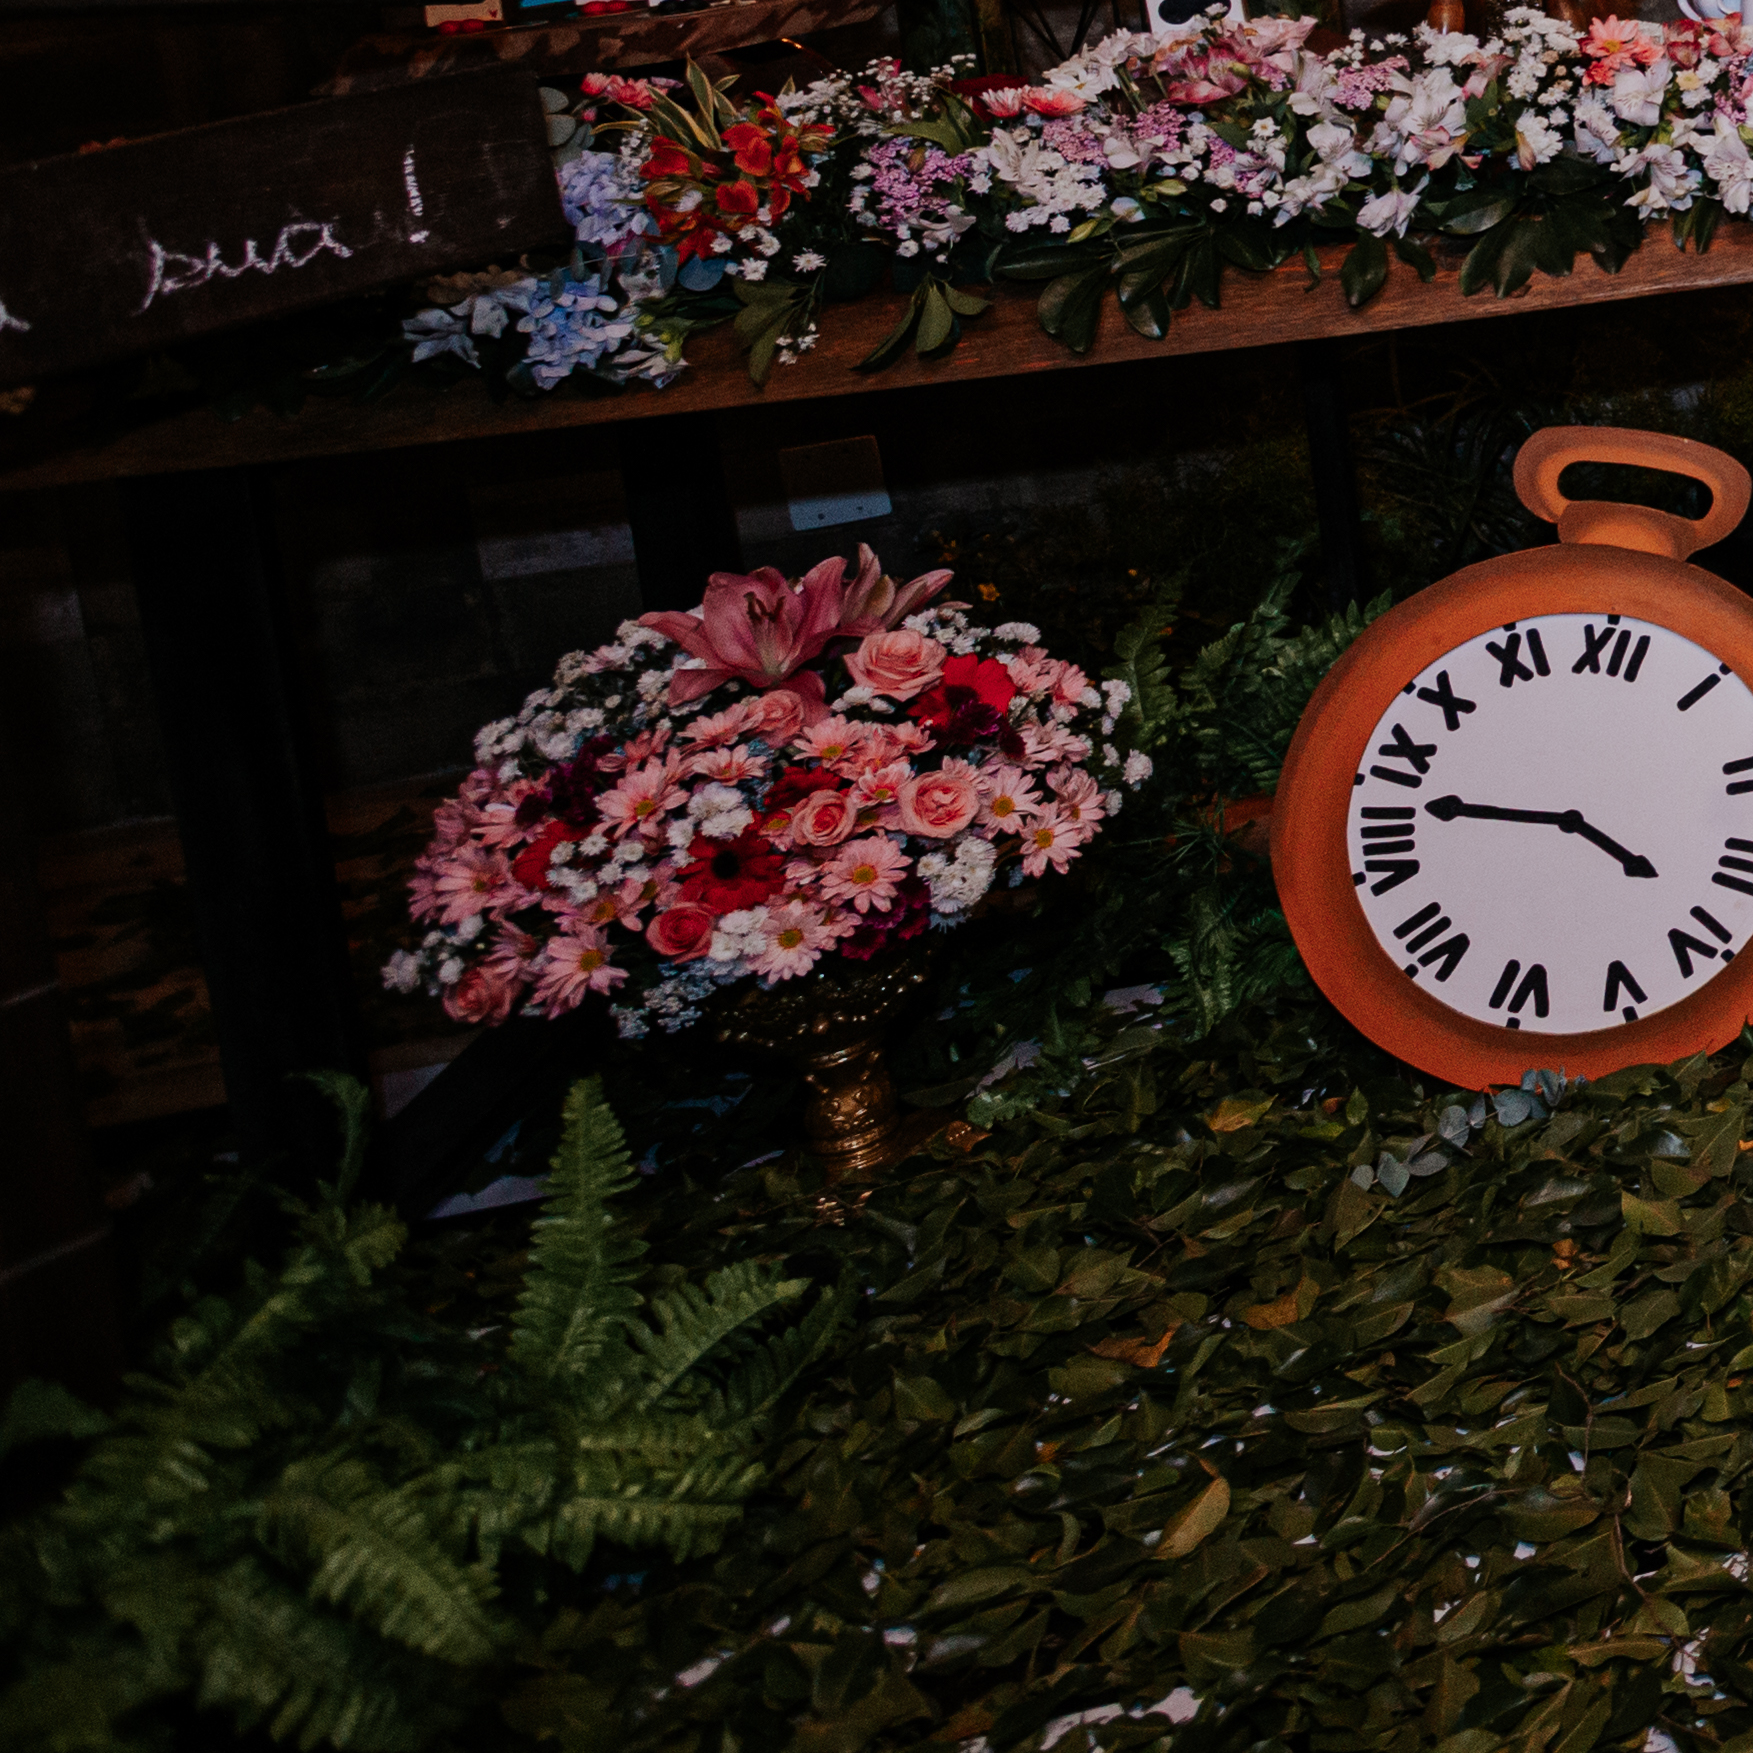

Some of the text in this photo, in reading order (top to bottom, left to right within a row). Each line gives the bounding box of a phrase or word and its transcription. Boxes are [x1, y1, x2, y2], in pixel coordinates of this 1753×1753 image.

[1485, 628, 1551, 688] XI
[1571, 624, 1651, 682] XII
[1416, 670, 1477, 731] X
[1676, 672, 1721, 712] I
[1369, 723, 1437, 788] IX
[1360, 806, 1420, 897] VIII
[1393, 901, 1470, 983] VII
[1667, 905, 1733, 979] IV
[1488, 959, 1549, 1018] VI
[1603, 960, 1648, 1012] V
